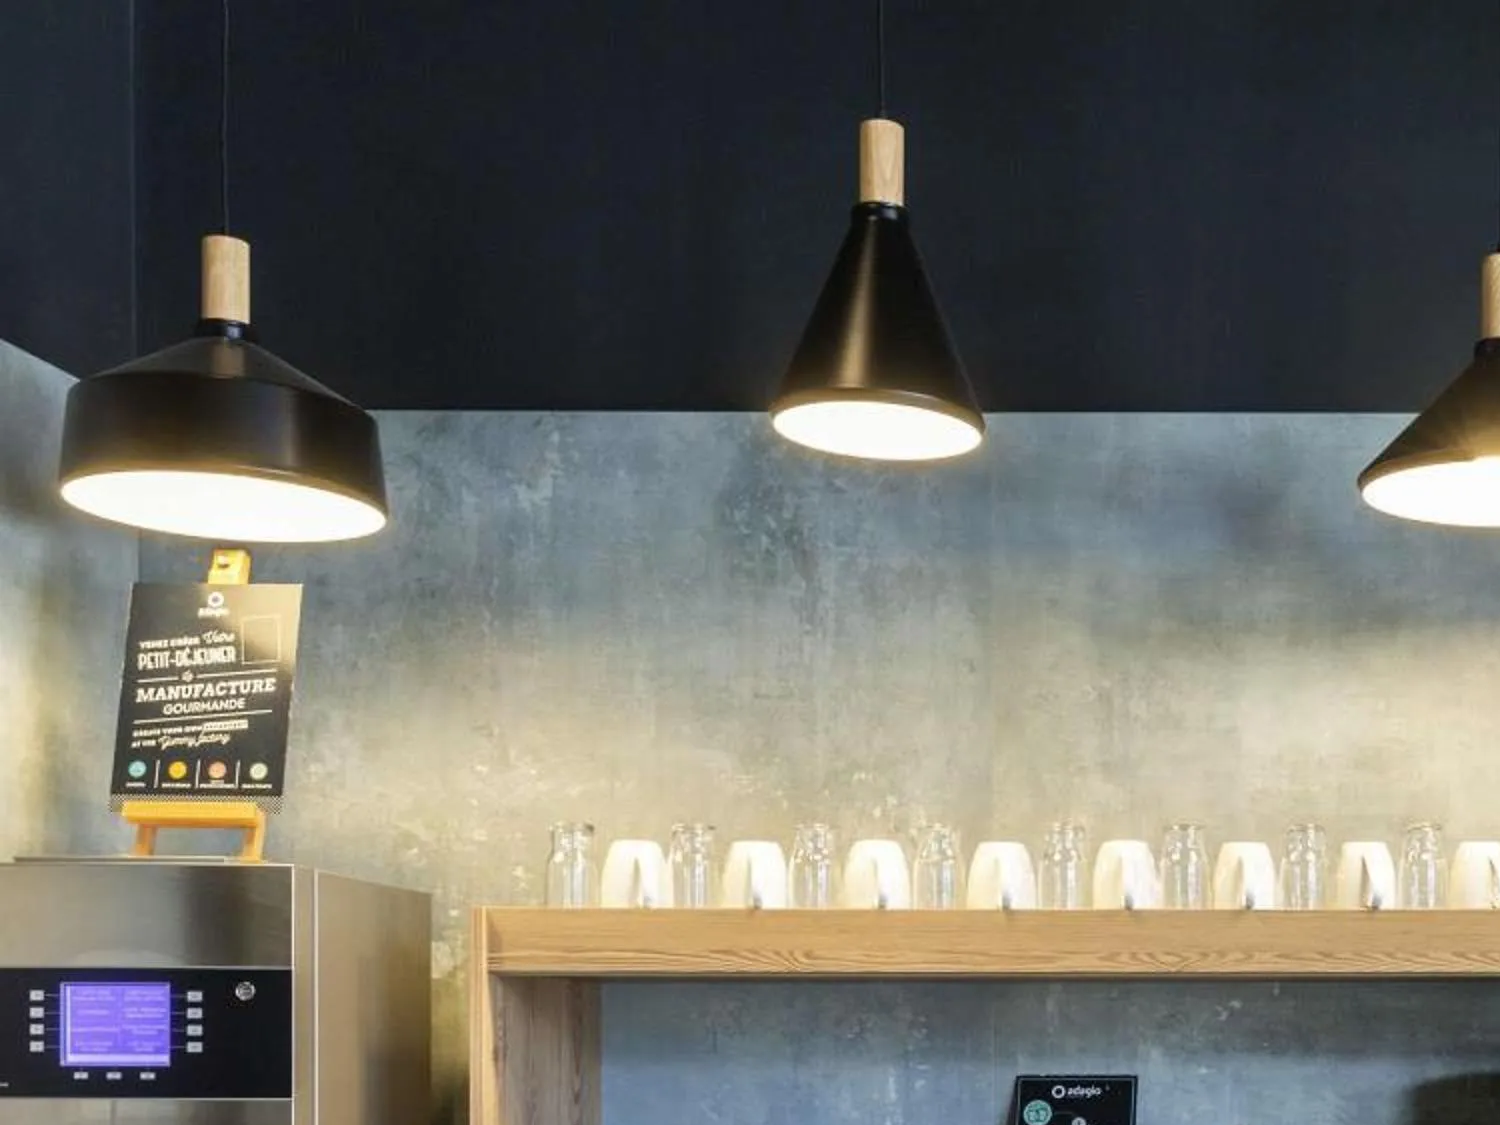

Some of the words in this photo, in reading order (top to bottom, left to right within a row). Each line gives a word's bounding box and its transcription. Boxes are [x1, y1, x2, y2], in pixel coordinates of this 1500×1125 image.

[137, 646, 236, 670] PETIT-DÉJEUNER
[136, 678, 276, 703] MANUFACTURE
[163, 698, 246, 715] GOURMANDE
